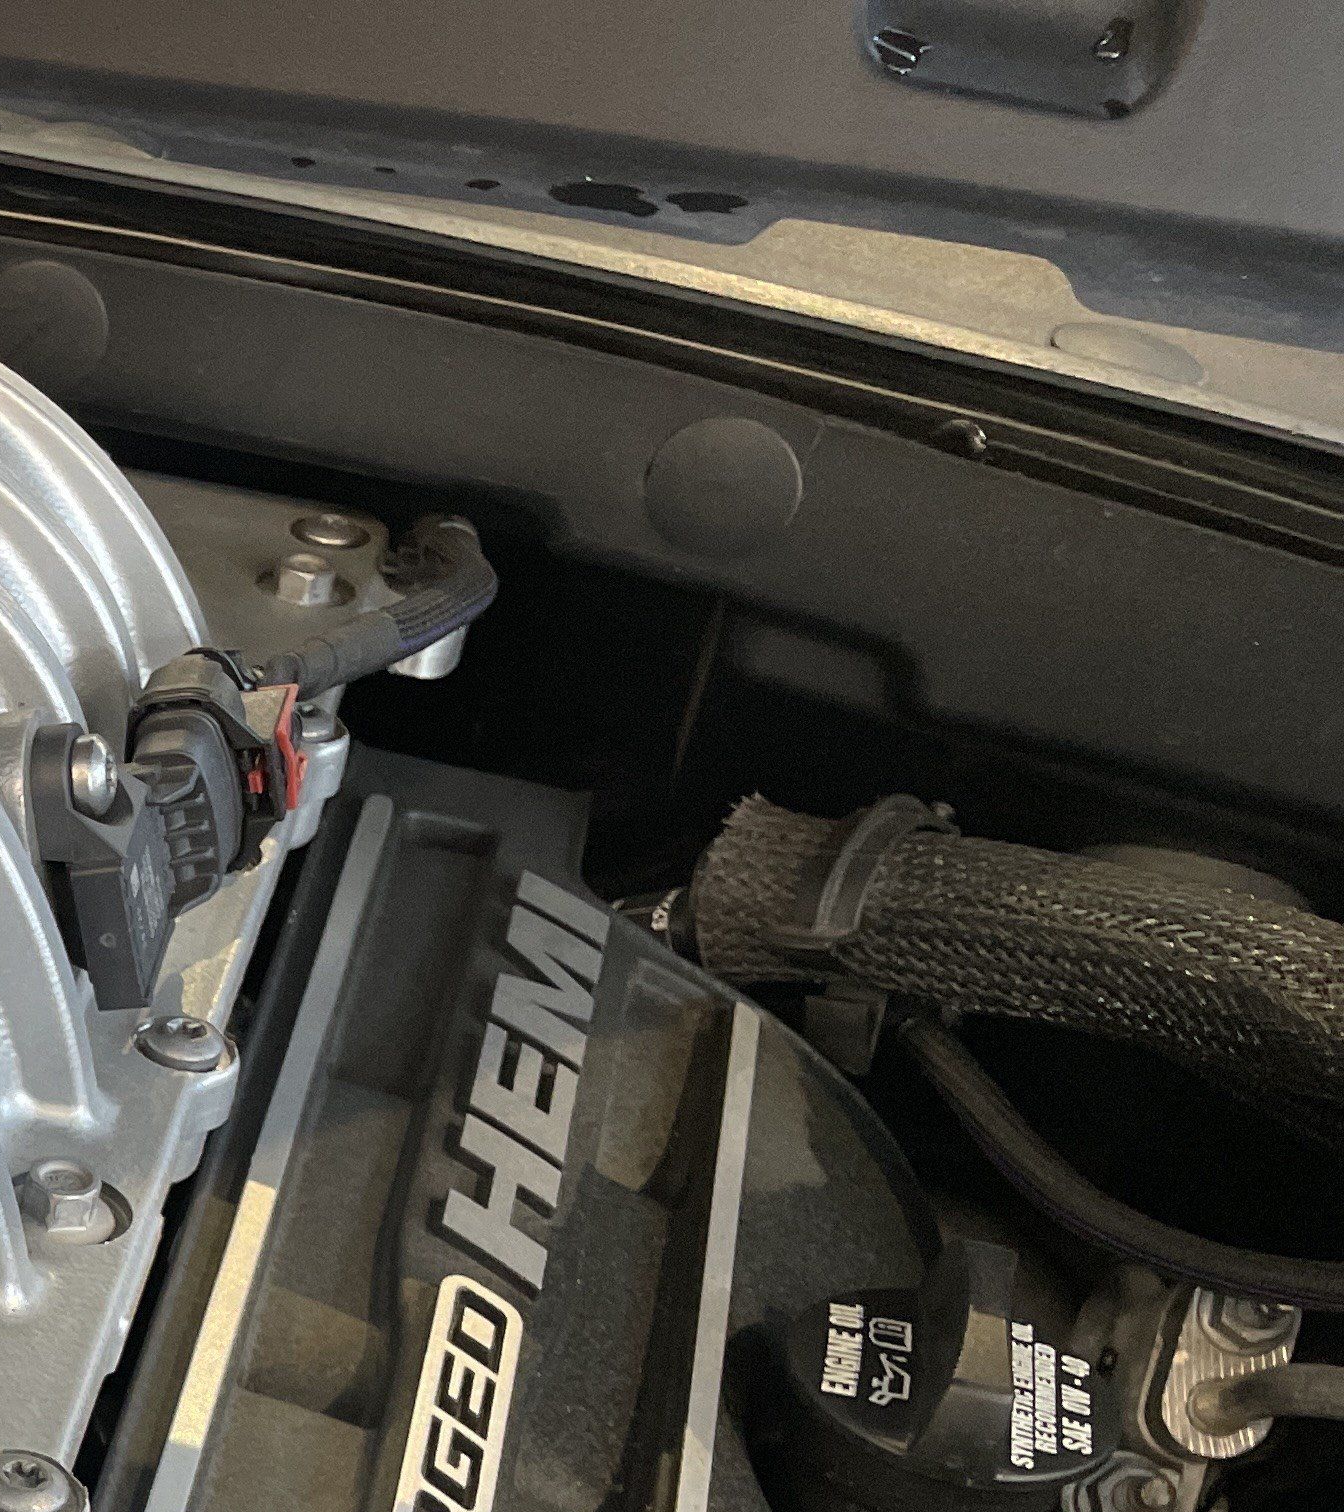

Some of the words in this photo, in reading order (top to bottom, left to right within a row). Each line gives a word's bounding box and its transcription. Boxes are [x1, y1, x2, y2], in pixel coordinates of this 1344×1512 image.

[442, 869, 611, 1290] HEMI
[828, 1303, 864, 1328] OIL
[1011, 1321, 1033, 1342] OIL
[821, 1328, 863, 1397] ENGINE
[1012, 1341, 1034, 1390] ENGINE
[1034, 1342, 1058, 1455] RECOMMENDED
[1010, 1389, 1034, 1469] SYNTHETIC
[1061, 1417, 1092, 1455] SAE
